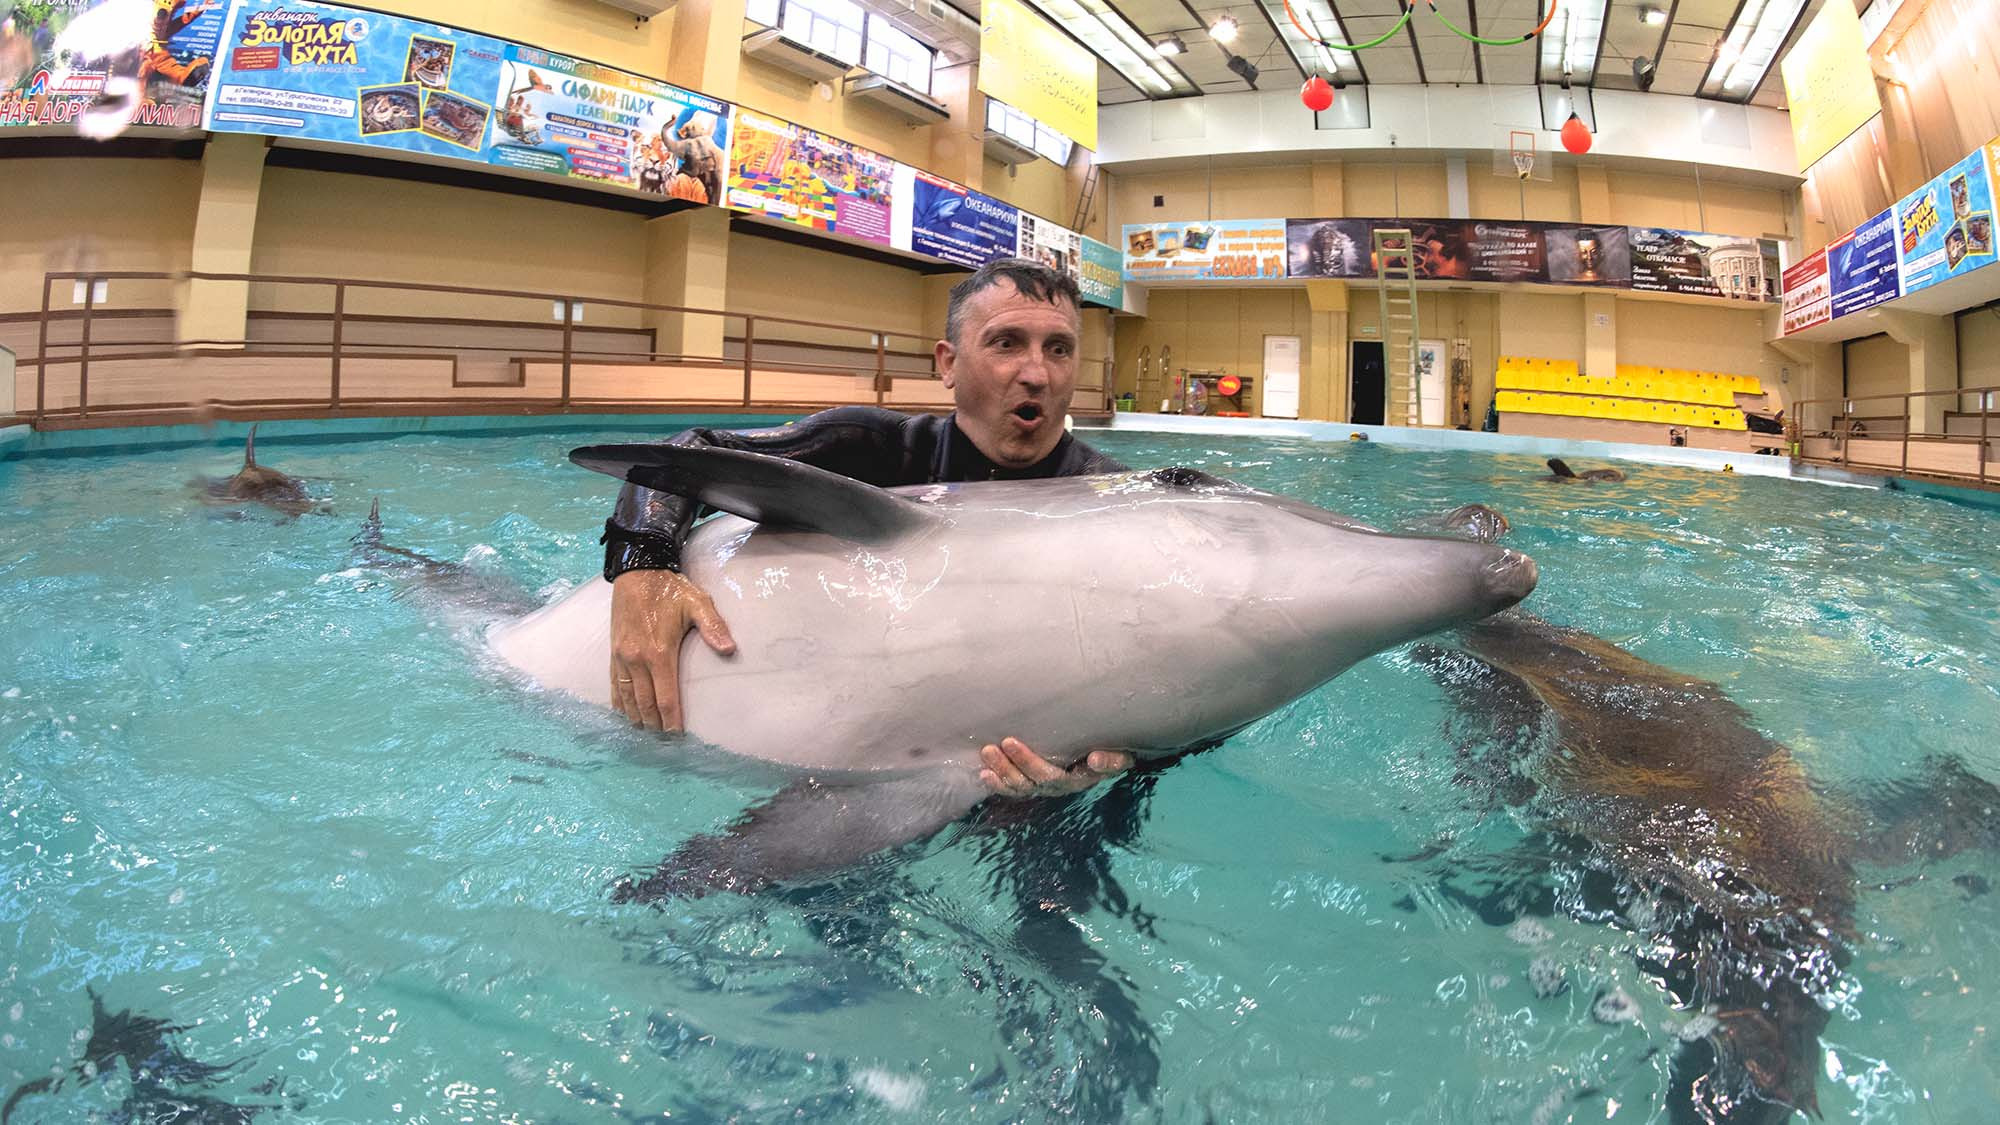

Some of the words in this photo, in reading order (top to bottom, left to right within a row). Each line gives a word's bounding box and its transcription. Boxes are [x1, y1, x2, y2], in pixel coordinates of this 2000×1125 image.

[291, 41, 358, 65] БУХТА
[562, 79, 654, 116] САФАРИ-ПАРК
[965, 196, 1017, 226] ОКЕАНАРИУМ
[1635, 244, 1659, 253] ТЕАТР
